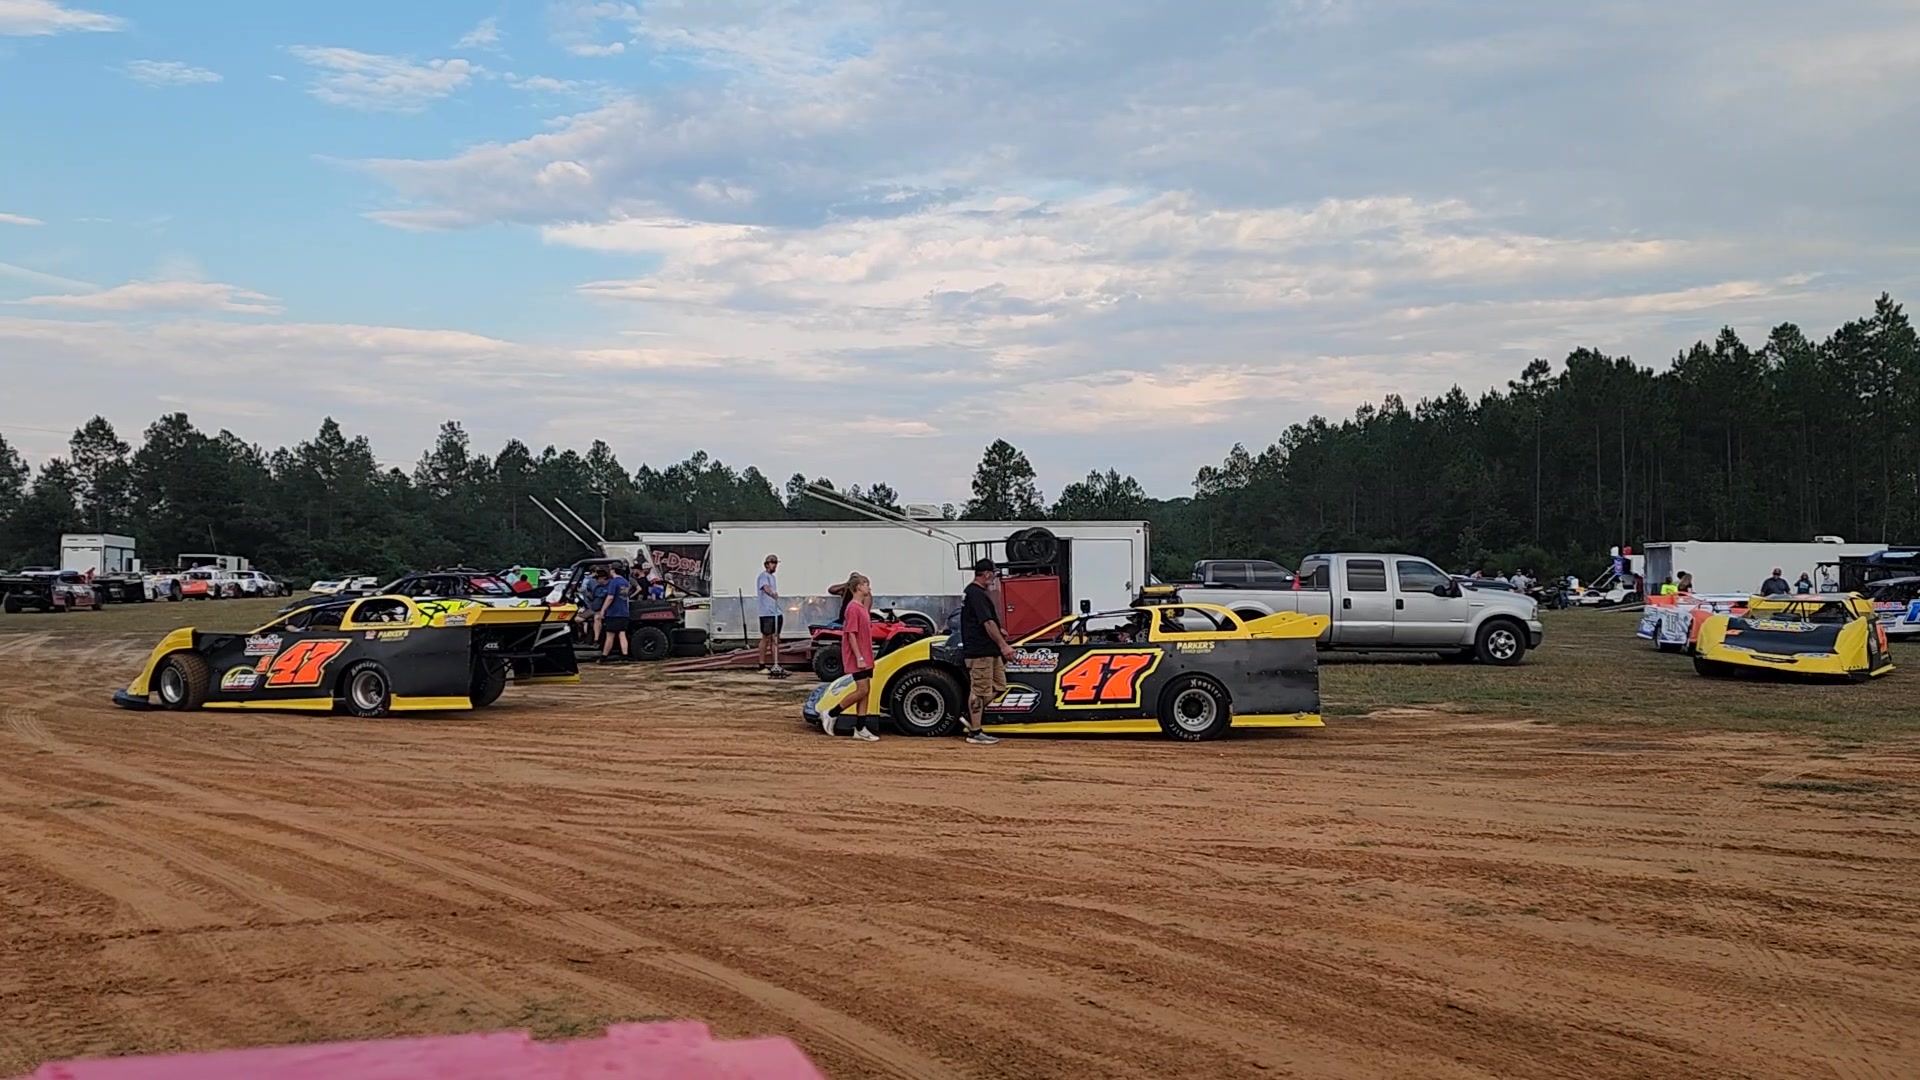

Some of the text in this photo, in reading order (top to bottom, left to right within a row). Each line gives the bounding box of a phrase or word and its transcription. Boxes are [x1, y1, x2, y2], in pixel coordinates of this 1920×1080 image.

[1176, 641, 1215, 651] PARKER'S
[267, 641, 347, 685] 47
[894, 676, 921, 702] Hoosier
[1060, 653, 1153, 701] 47
[1190, 679, 1222, 698] Hoosier
